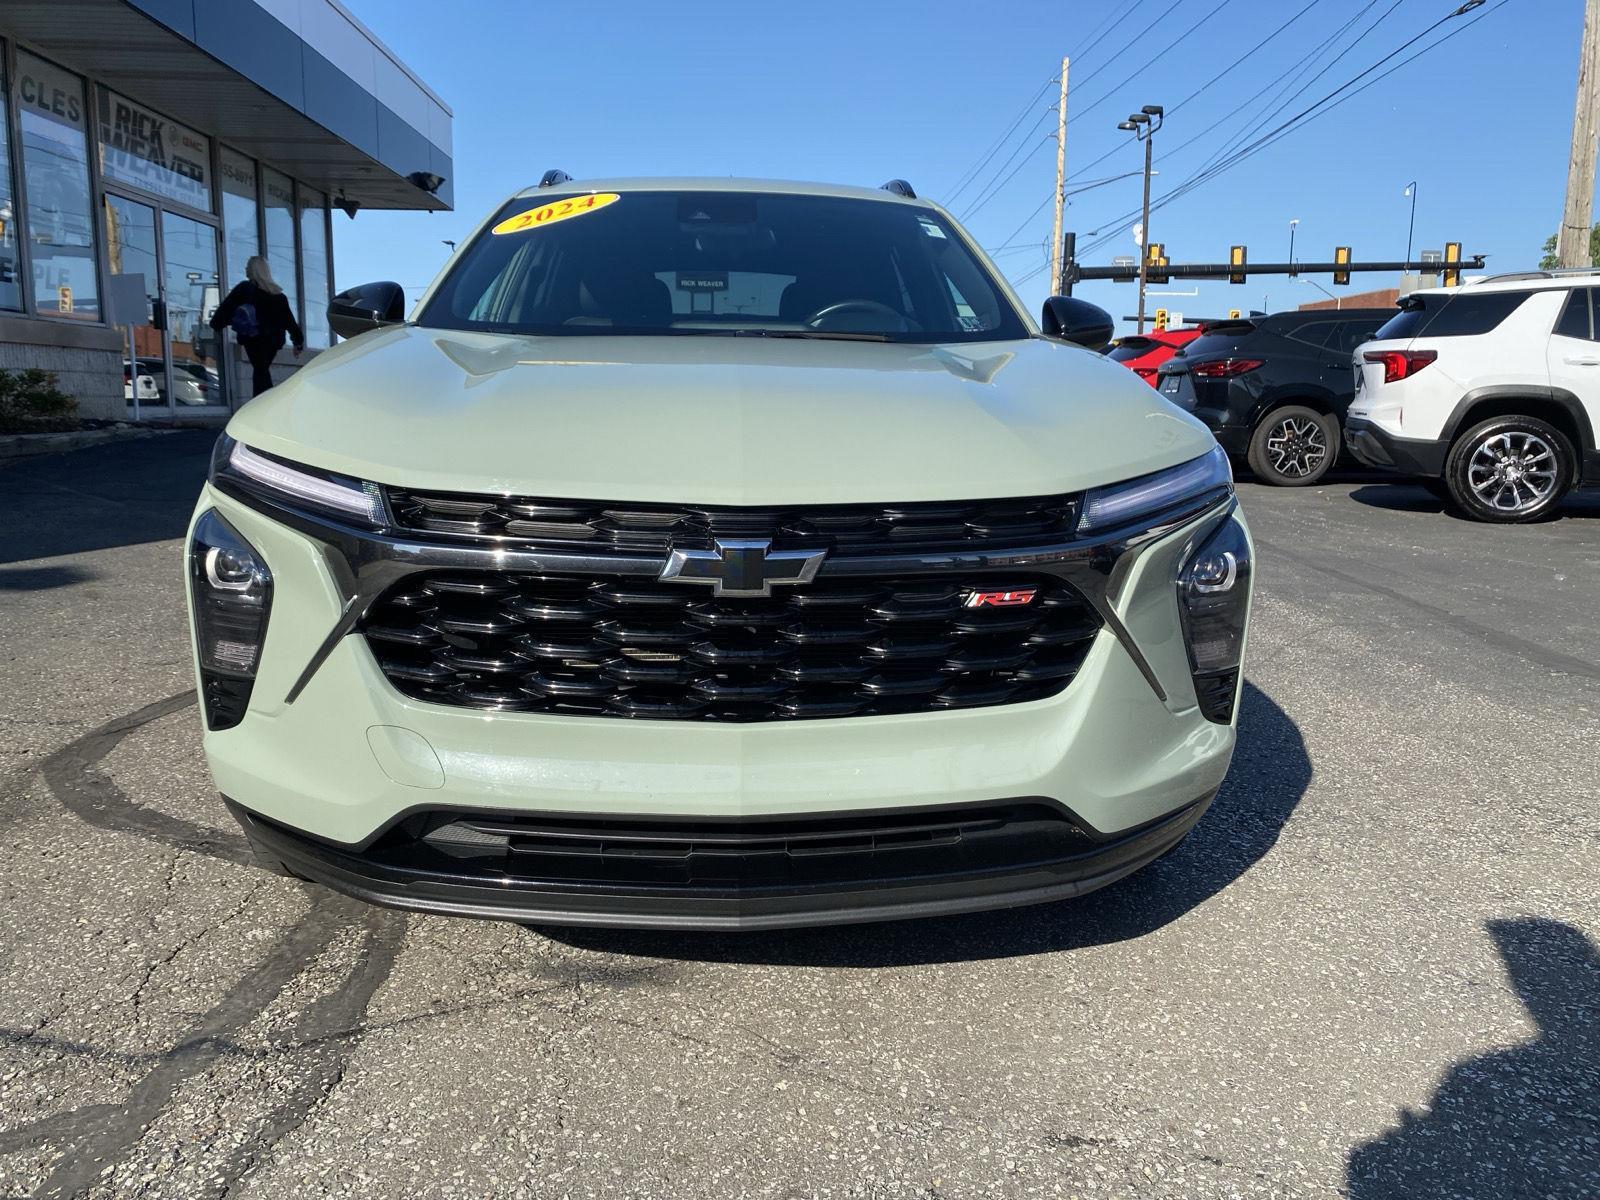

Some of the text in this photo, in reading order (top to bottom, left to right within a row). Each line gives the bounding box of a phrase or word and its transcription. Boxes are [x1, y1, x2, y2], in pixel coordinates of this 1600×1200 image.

[21, 75, 80, 122] CLES
[515, 196, 596, 230] 2024
[967, 589, 1037, 607] RS
